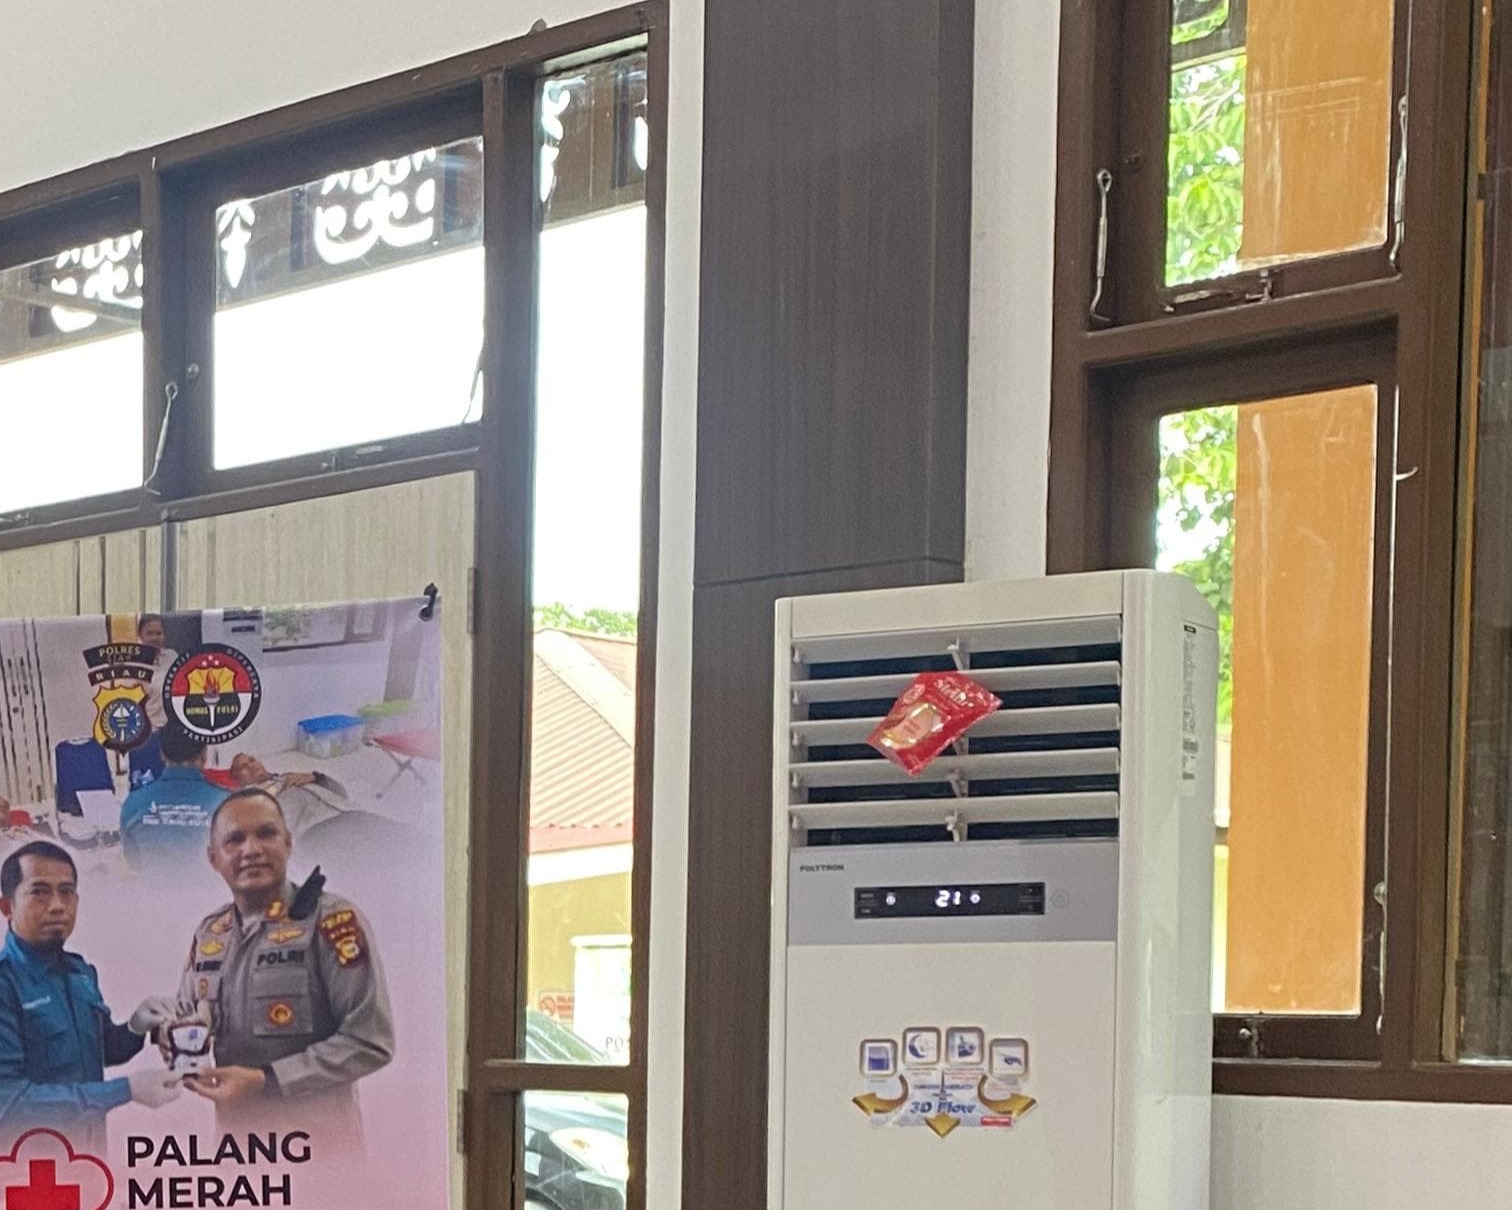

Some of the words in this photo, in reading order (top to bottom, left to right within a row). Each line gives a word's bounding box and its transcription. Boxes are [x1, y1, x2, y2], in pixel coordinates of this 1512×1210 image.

[98, 645, 141, 657] POLRES
[95, 668, 147, 681] RIAU
[935, 889, 961, 908] 21
[909, 1101, 933, 1114] 3D
[937, 1100, 977, 1115] Flow
[127, 1130, 312, 1168] PALANG
[128, 1173, 292, 1210] MERAH
